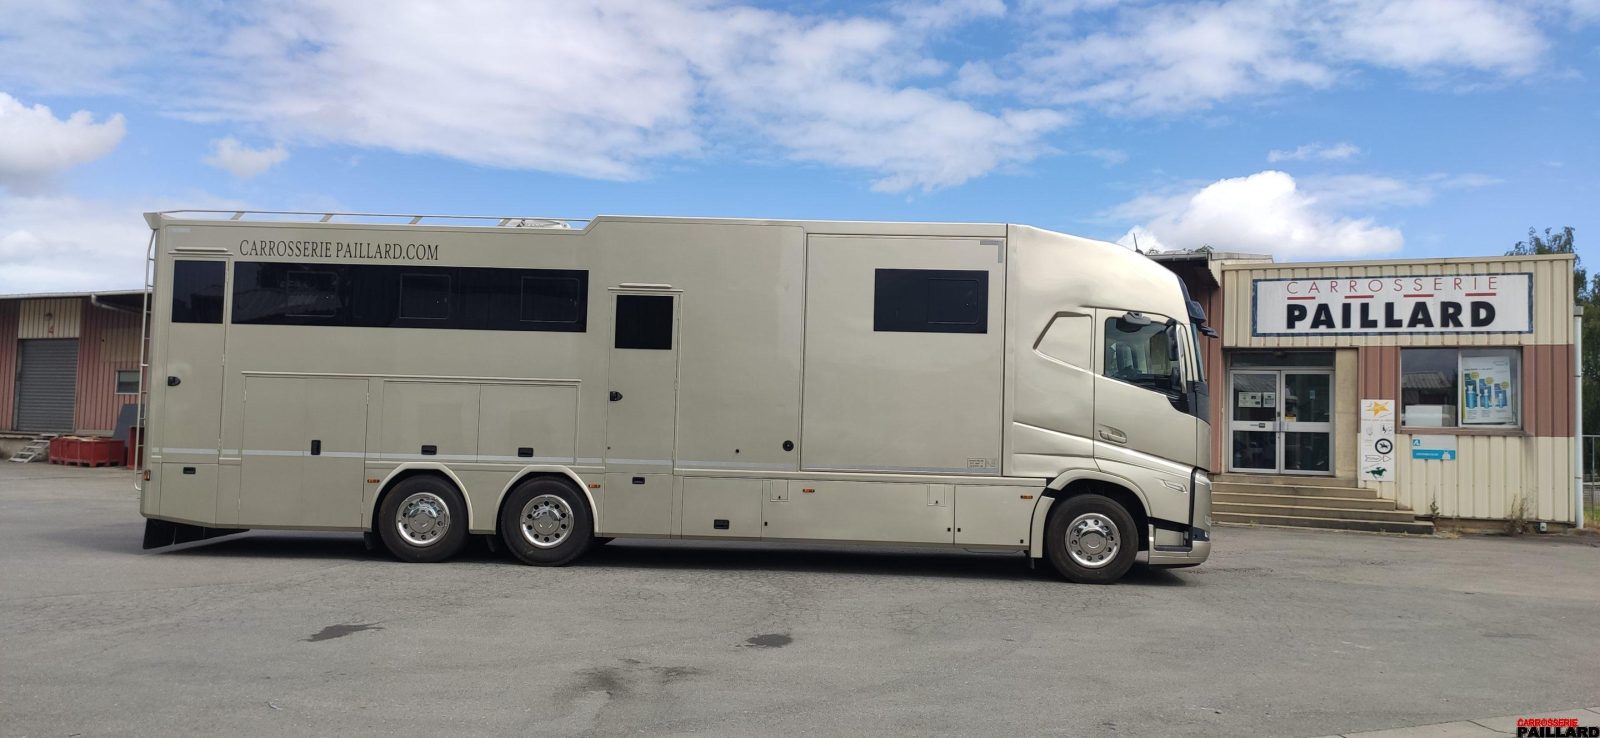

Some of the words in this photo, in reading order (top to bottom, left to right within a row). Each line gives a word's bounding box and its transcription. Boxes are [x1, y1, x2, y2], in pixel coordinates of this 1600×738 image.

[239, 239, 332, 258] CARROSSERIE
[336, 242, 439, 261] PAILLARD.COM
[1286, 276, 1498, 294] CARROSSERIE
[1286, 300, 1496, 329] PAILLARD
